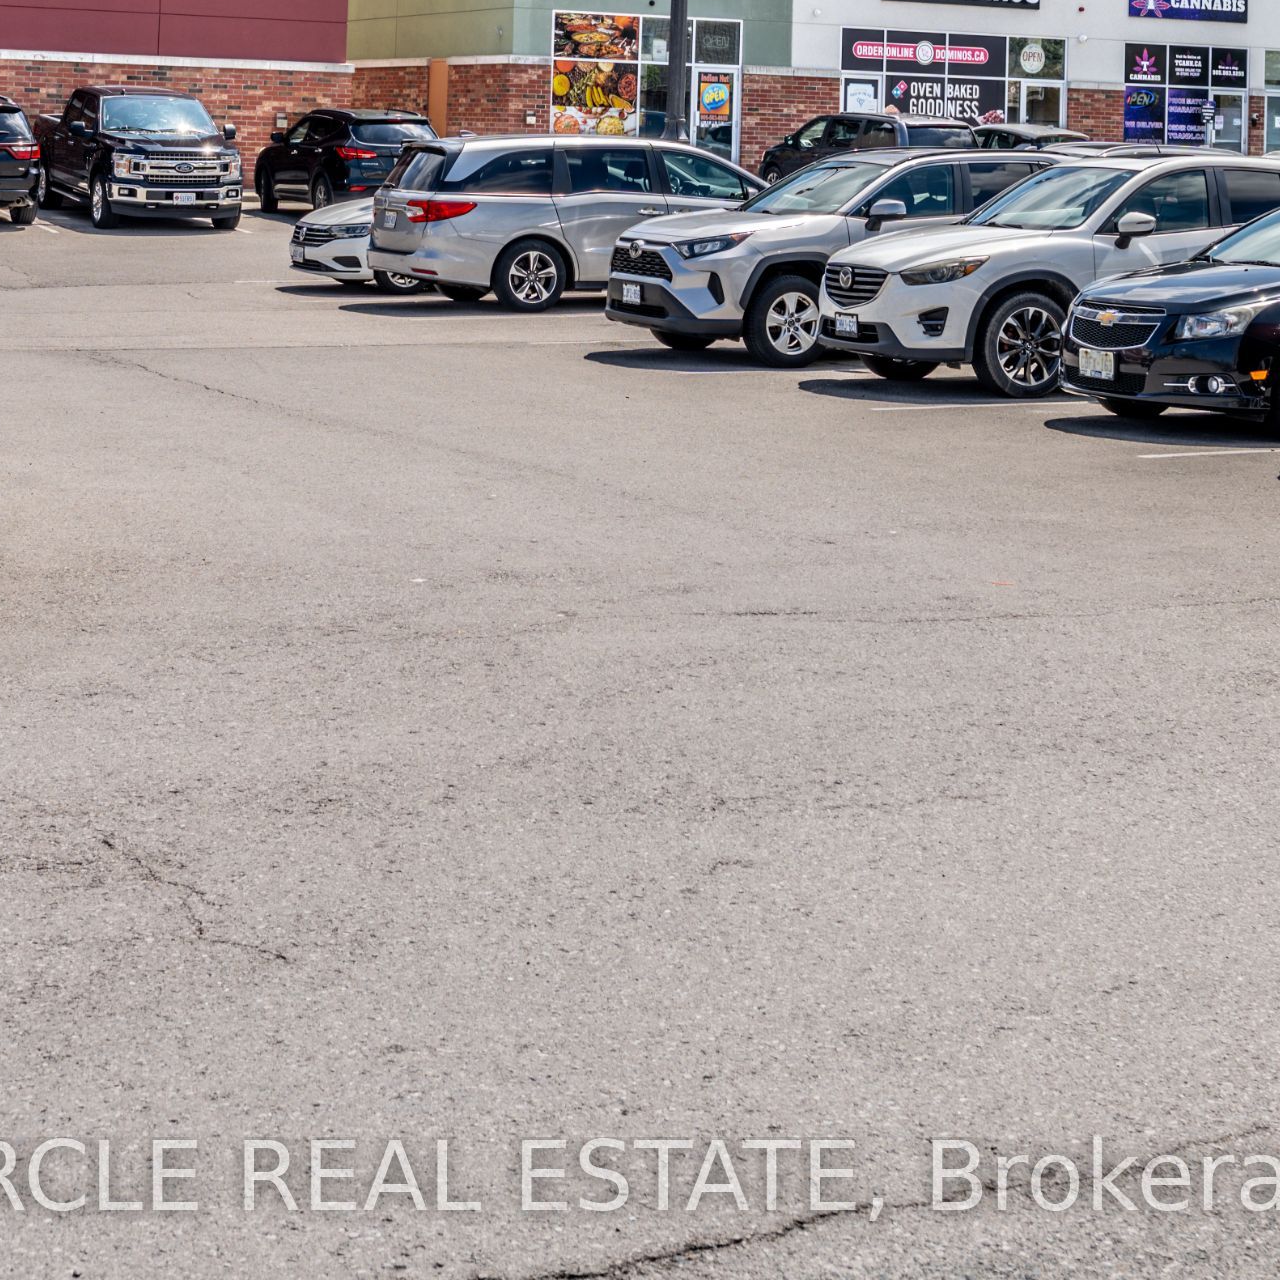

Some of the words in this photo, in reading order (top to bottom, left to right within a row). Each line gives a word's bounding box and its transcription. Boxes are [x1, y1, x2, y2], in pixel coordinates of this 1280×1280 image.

[856, 45, 884, 57] ORDER
[886, 46, 914, 58] ONLINE
[935, 49, 985, 62] DOMINOS.CA
[1022, 50, 1043, 62] OPEN
[1129, 73, 1161, 81] CANNABIS
[704, 89, 725, 104] OPEN
[910, 81, 941, 97] OVEN
[947, 83, 980, 100] BAKED
[909, 98, 979, 118] GOODNESS
[1138, 121, 1163, 129] DELIVER
